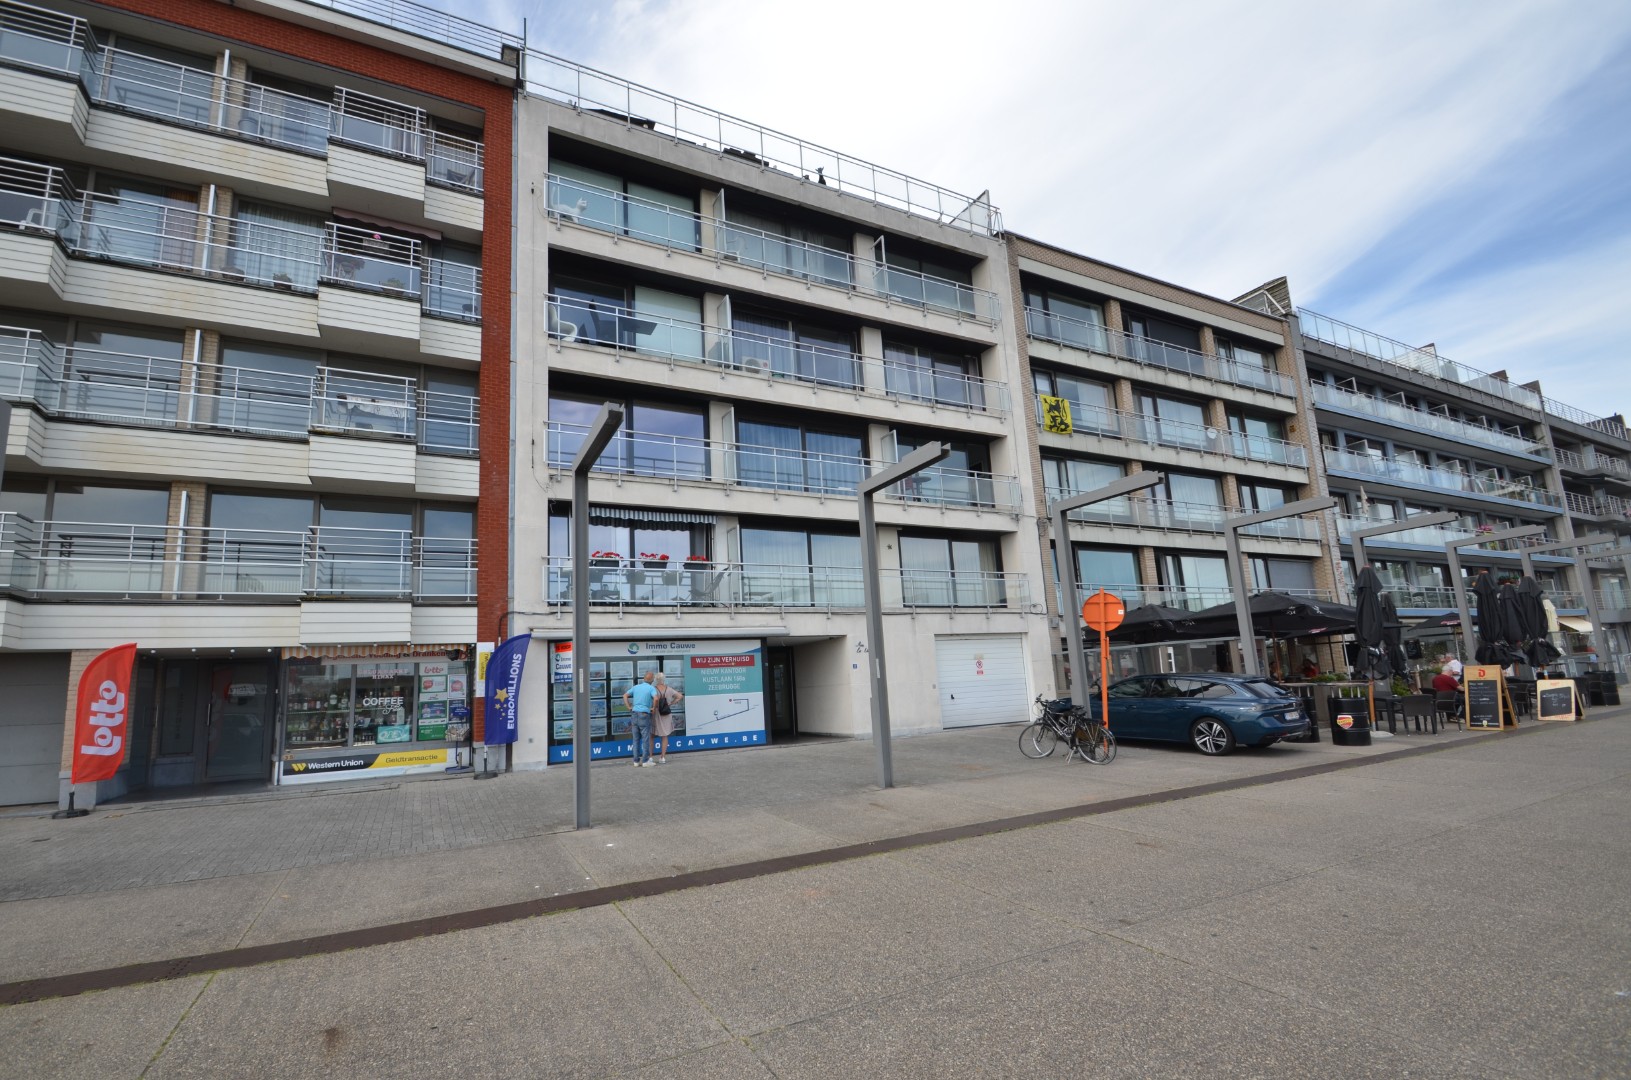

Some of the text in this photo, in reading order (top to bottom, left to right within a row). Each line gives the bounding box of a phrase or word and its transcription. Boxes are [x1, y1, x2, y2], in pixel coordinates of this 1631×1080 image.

[645, 642, 668, 650] Immo
[507, 653, 522, 730] EUROMILLIONS
[363, 696, 404, 706] COFFEE
[560, 734, 758, 757] WW.IMO-CAUWE.BE
[385, 753, 438, 763] Geldtransactie
[308, 759, 364, 770] Western Union
